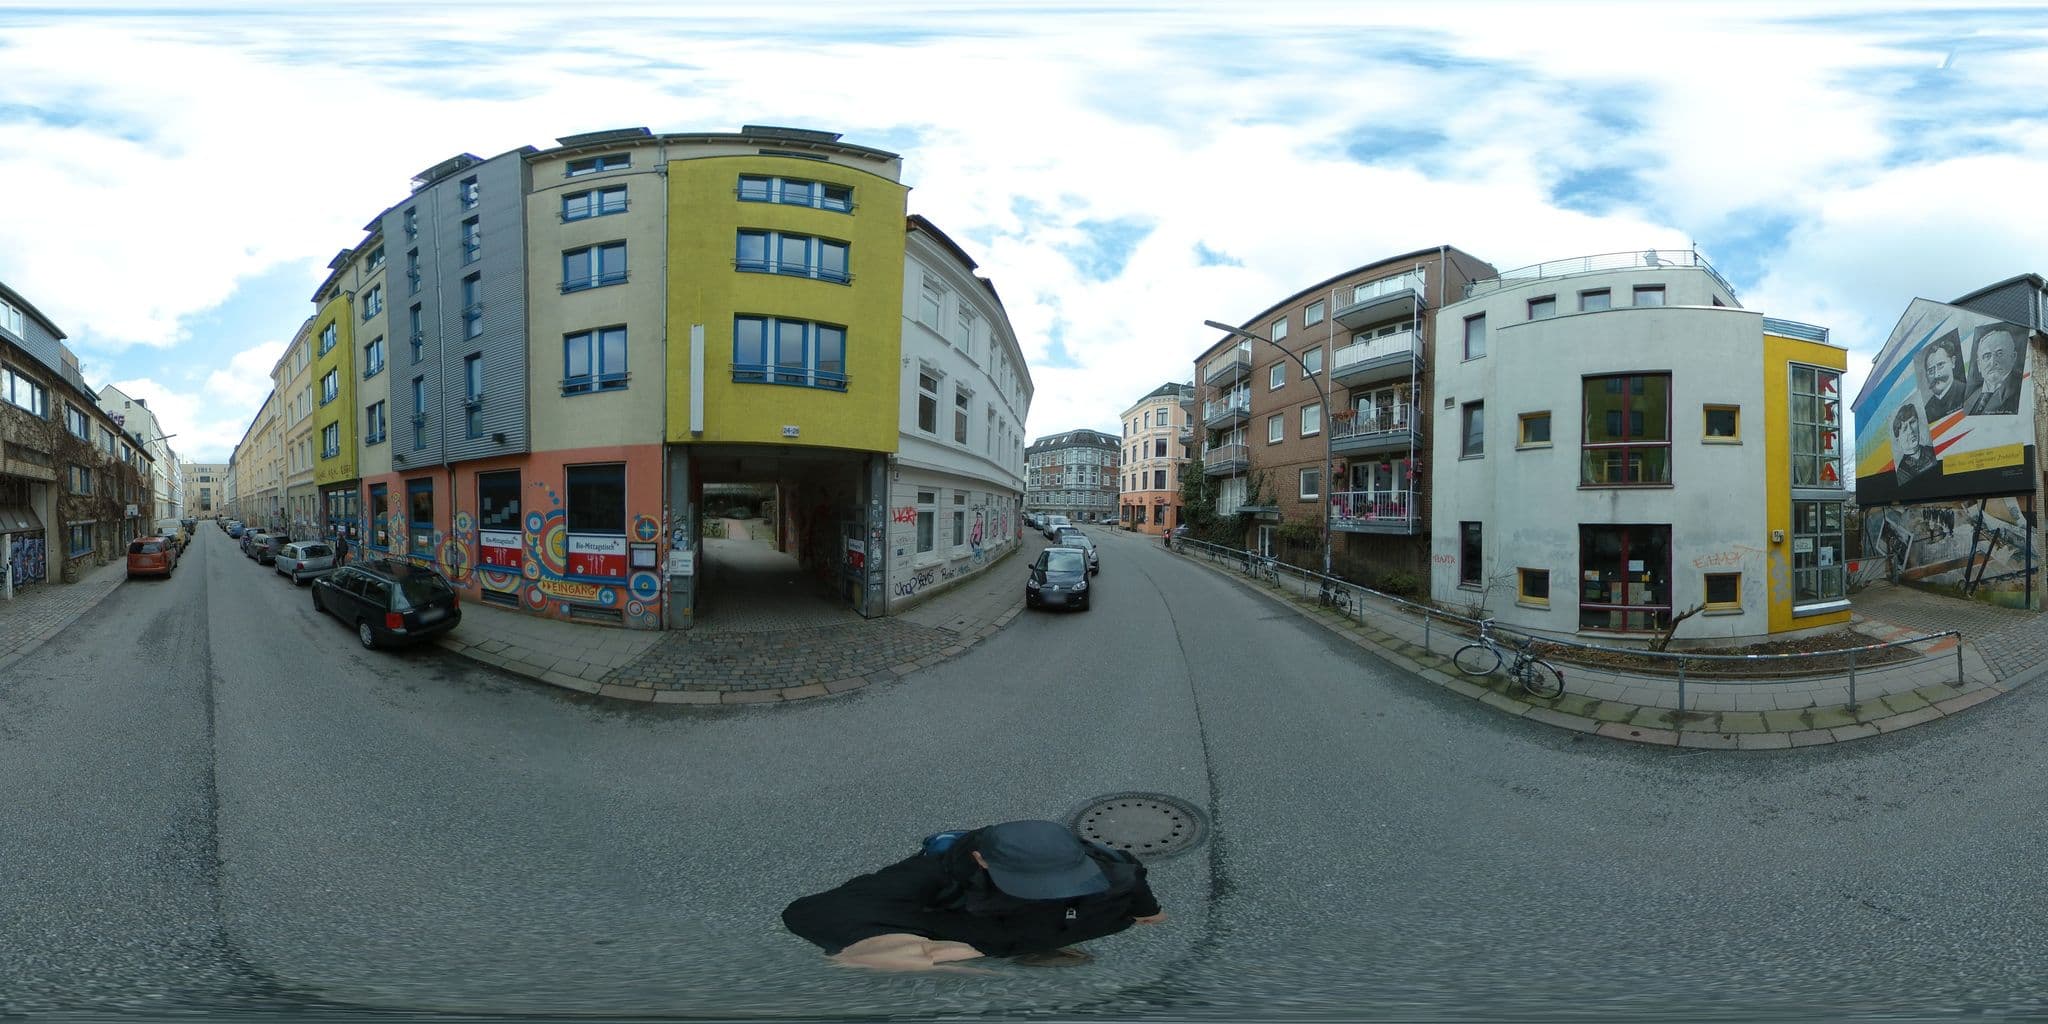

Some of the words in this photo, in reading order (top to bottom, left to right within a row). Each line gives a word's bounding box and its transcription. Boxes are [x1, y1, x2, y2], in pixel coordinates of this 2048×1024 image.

[1818, 376, 1838, 482] KITA
[576, 541, 615, 551] Bio-Mittagstisch
[552, 582, 595, 596] EINGANG
